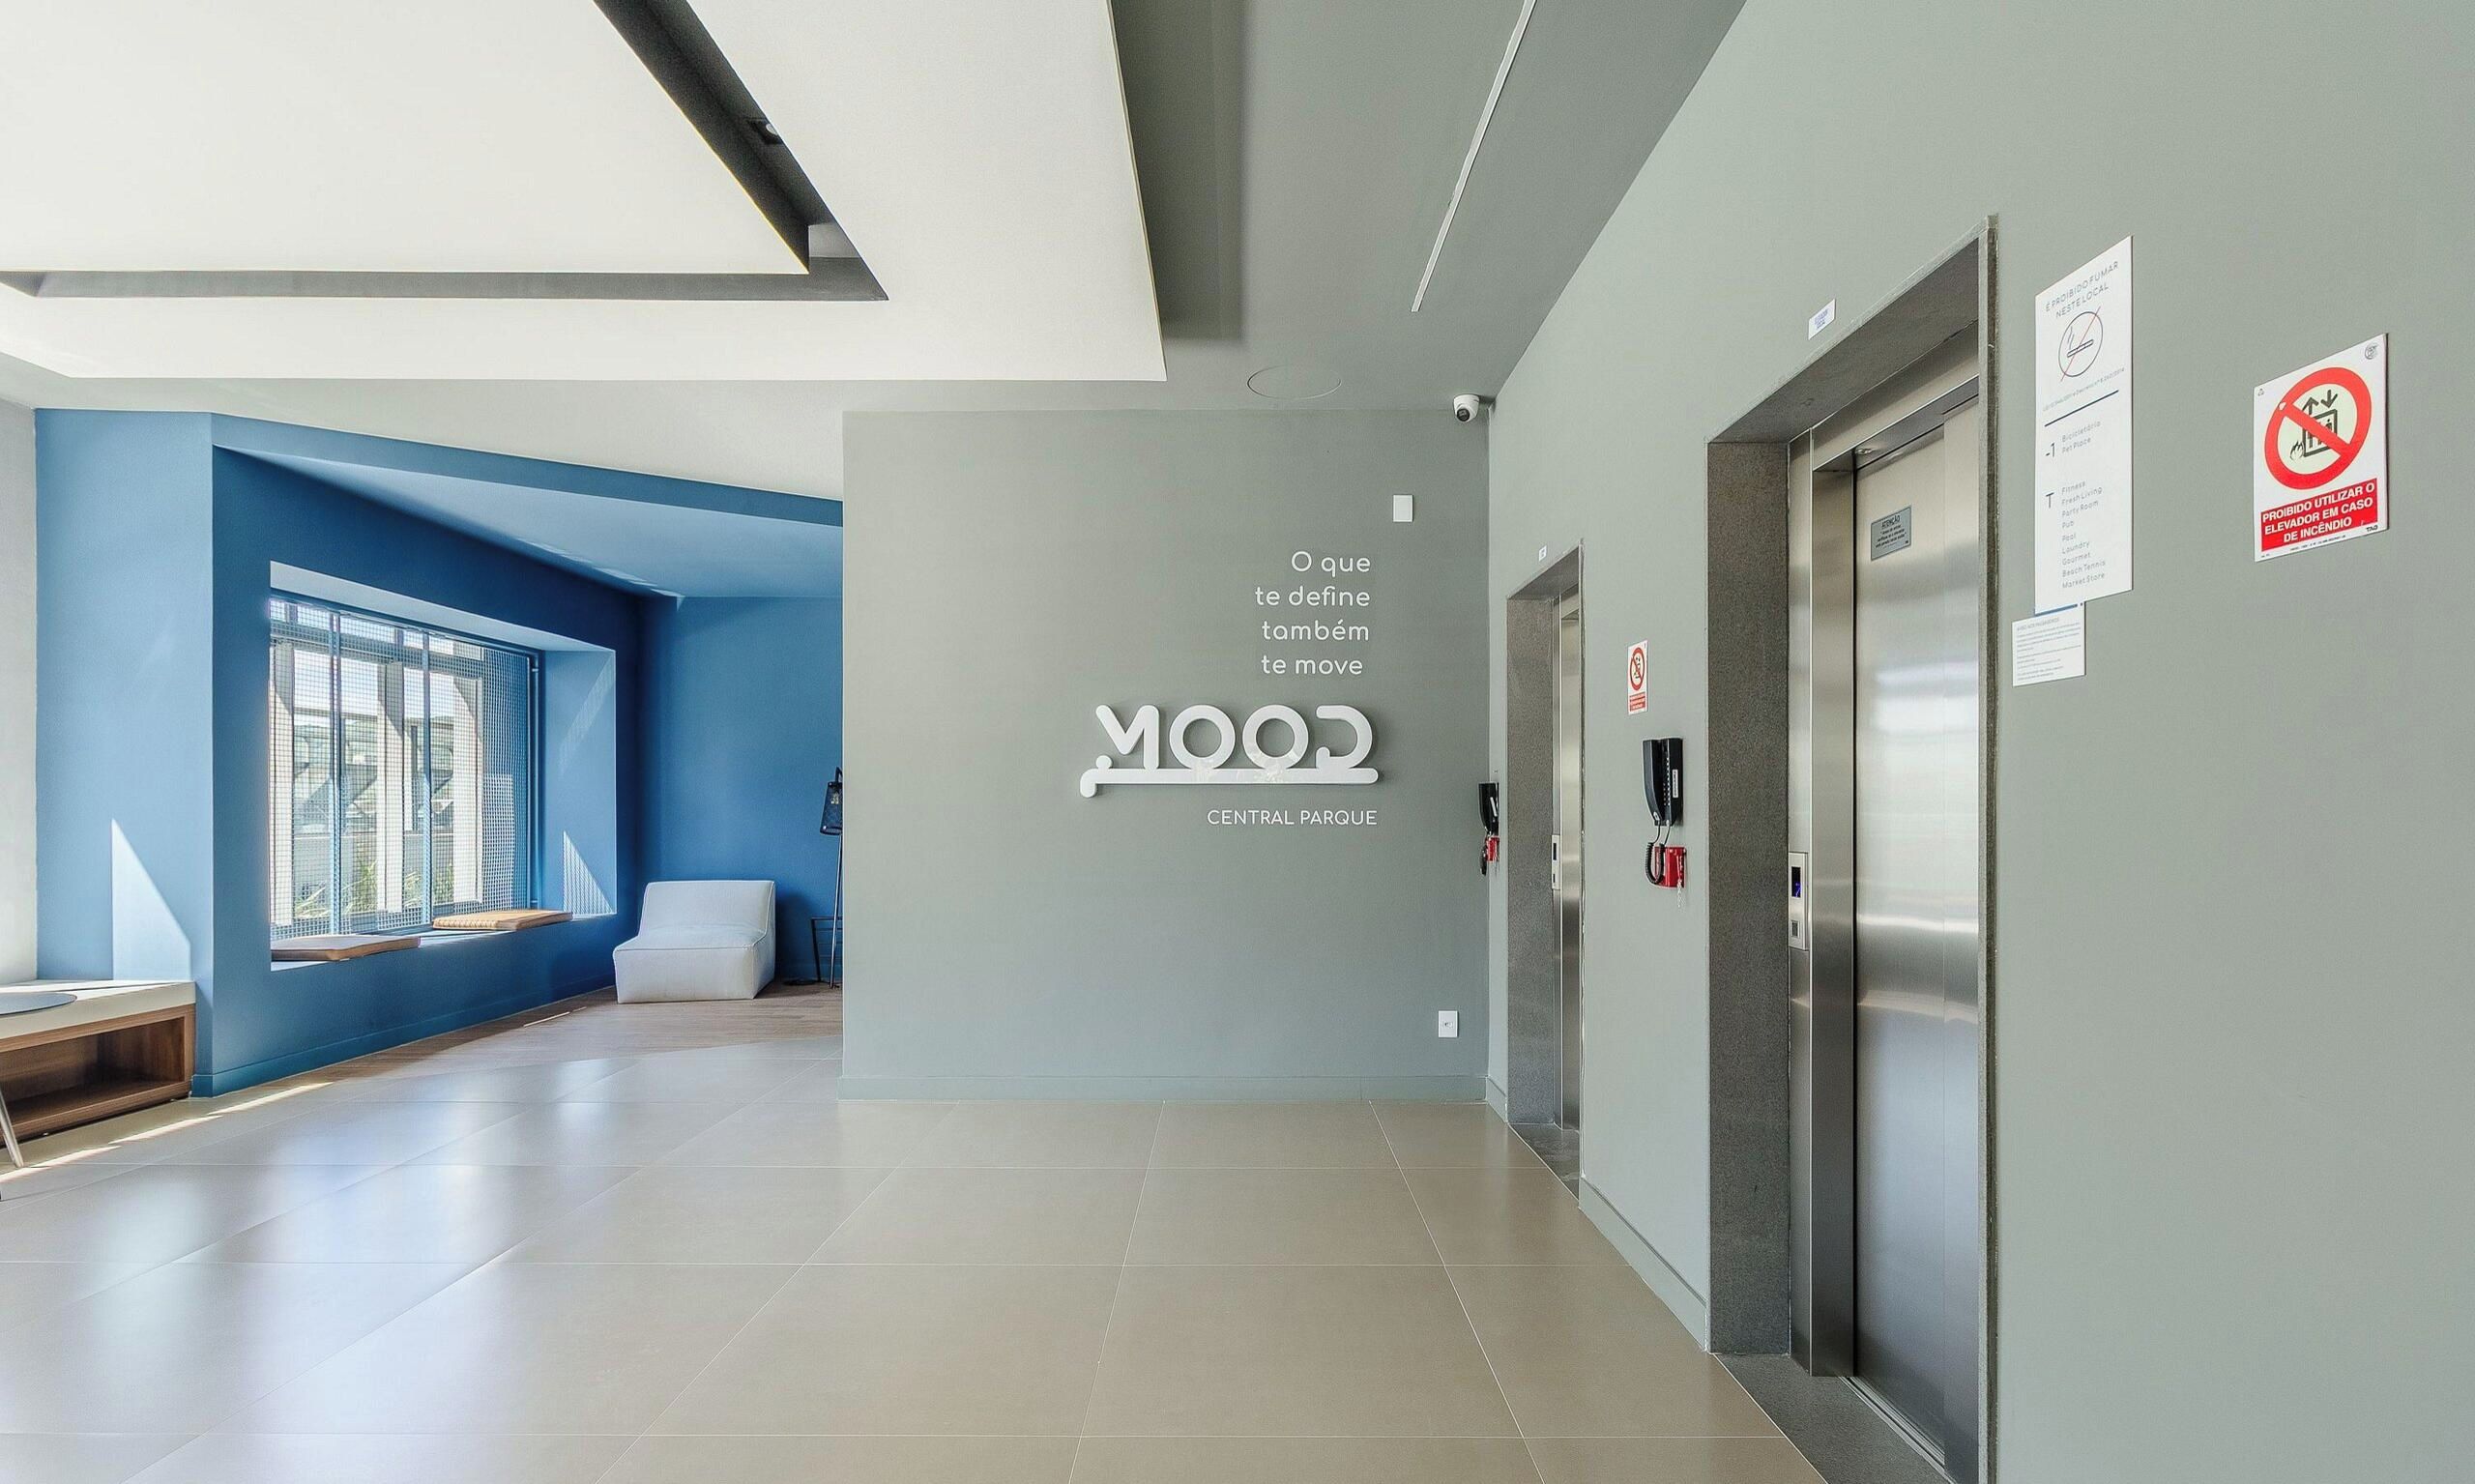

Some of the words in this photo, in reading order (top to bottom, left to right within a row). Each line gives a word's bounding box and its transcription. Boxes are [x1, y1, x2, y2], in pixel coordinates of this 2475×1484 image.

[2052, 279, 2088, 307] PROIBIDO
[2089, 260, 2118, 283] FUMAR
[2055, 297, 2082, 318] NESTE
[2082, 282, 2109, 304] LOCAL
[2073, 436, 2091, 450] Place
[2061, 480, 2085, 496] Fitness
[2061, 494, 2080, 505] Fresh
[2081, 485, 2103, 500] Living
[2045, 492, 2054, 509] T
[2061, 508, 2080, 517] Party
[2080, 500, 2099, 510] Room
[2262, 501, 2312, 523] PROIBIDO
[2315, 485, 2363, 509] UTILIZAR
[2366, 482, 2375, 493] O
[2061, 519, 2075, 529] Pub
[2264, 511, 2319, 536] ELEVADOR
[2322, 506, 2339, 520] EM
[2341, 497, 2373, 515] CASO
[2284, 531, 2298, 543] DE
[2300, 516, 2352, 539] INCÊNDIO
[2061, 539, 2090, 555] Laundry
[1291, 551, 1312, 572] O
[1321, 553, 1371, 577] que
[2061, 551, 2091, 566] Gourmet
[2061, 566, 2082, 578] Beach
[2083, 560, 2106, 571] Tennis
[2061, 577, 2086, 589] Market
[2086, 572, 2106, 584] Store
[1255, 586, 1280, 606] te
[1288, 586, 1371, 607] define
[1262, 619, 1369, 641] também
[1262, 655, 1286, 675] te
[1295, 657, 1363, 675] move
[1207, 809, 1296, 826] CENTRAL
[1299, 809, 1378, 826] PARQUE
